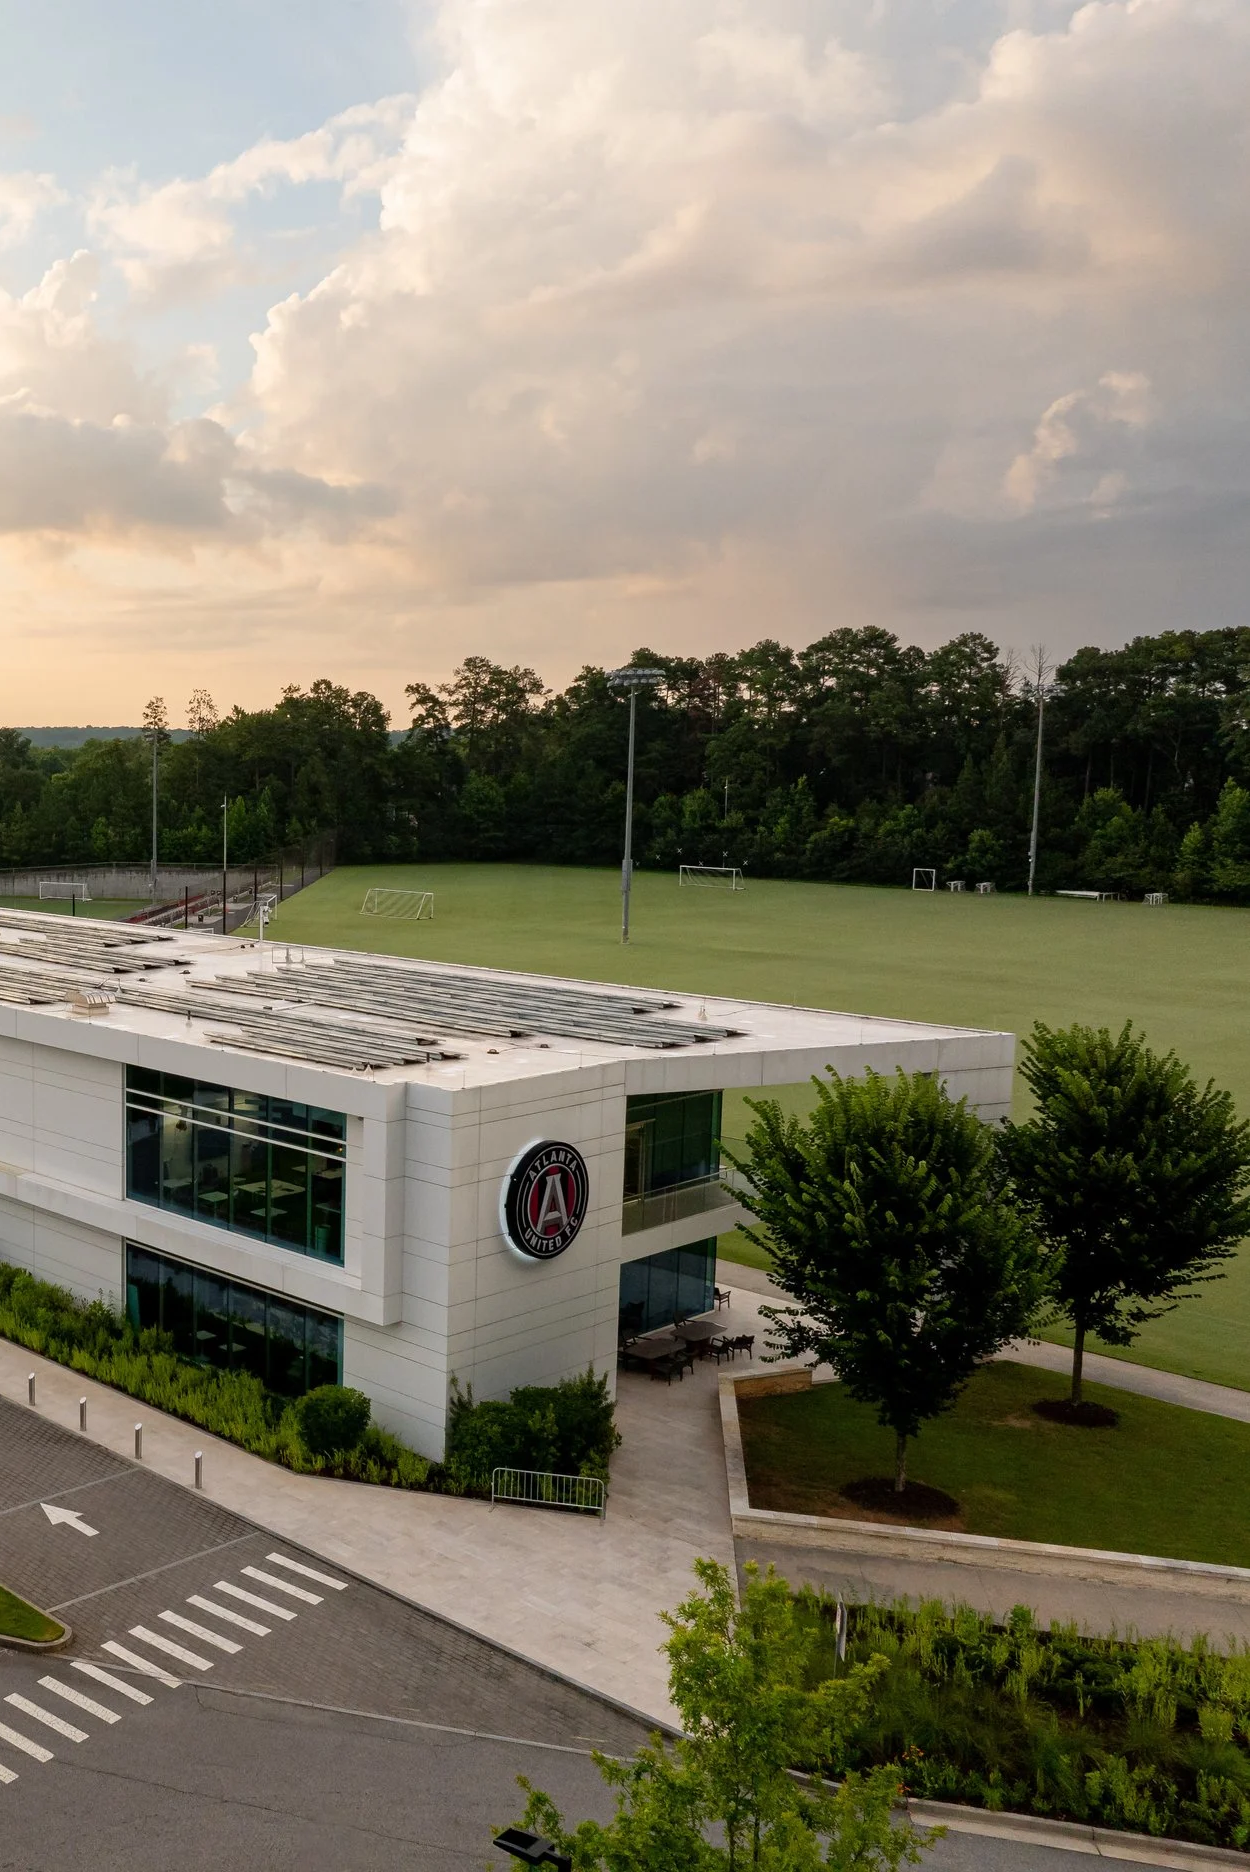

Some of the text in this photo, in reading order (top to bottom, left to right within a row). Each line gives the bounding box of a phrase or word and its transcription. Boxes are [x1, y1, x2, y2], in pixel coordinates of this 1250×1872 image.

[529, 1150, 578, 1182] ATLANTA
[536, 1172, 569, 1235] A
[524, 1216, 579, 1252] UNITED FC
